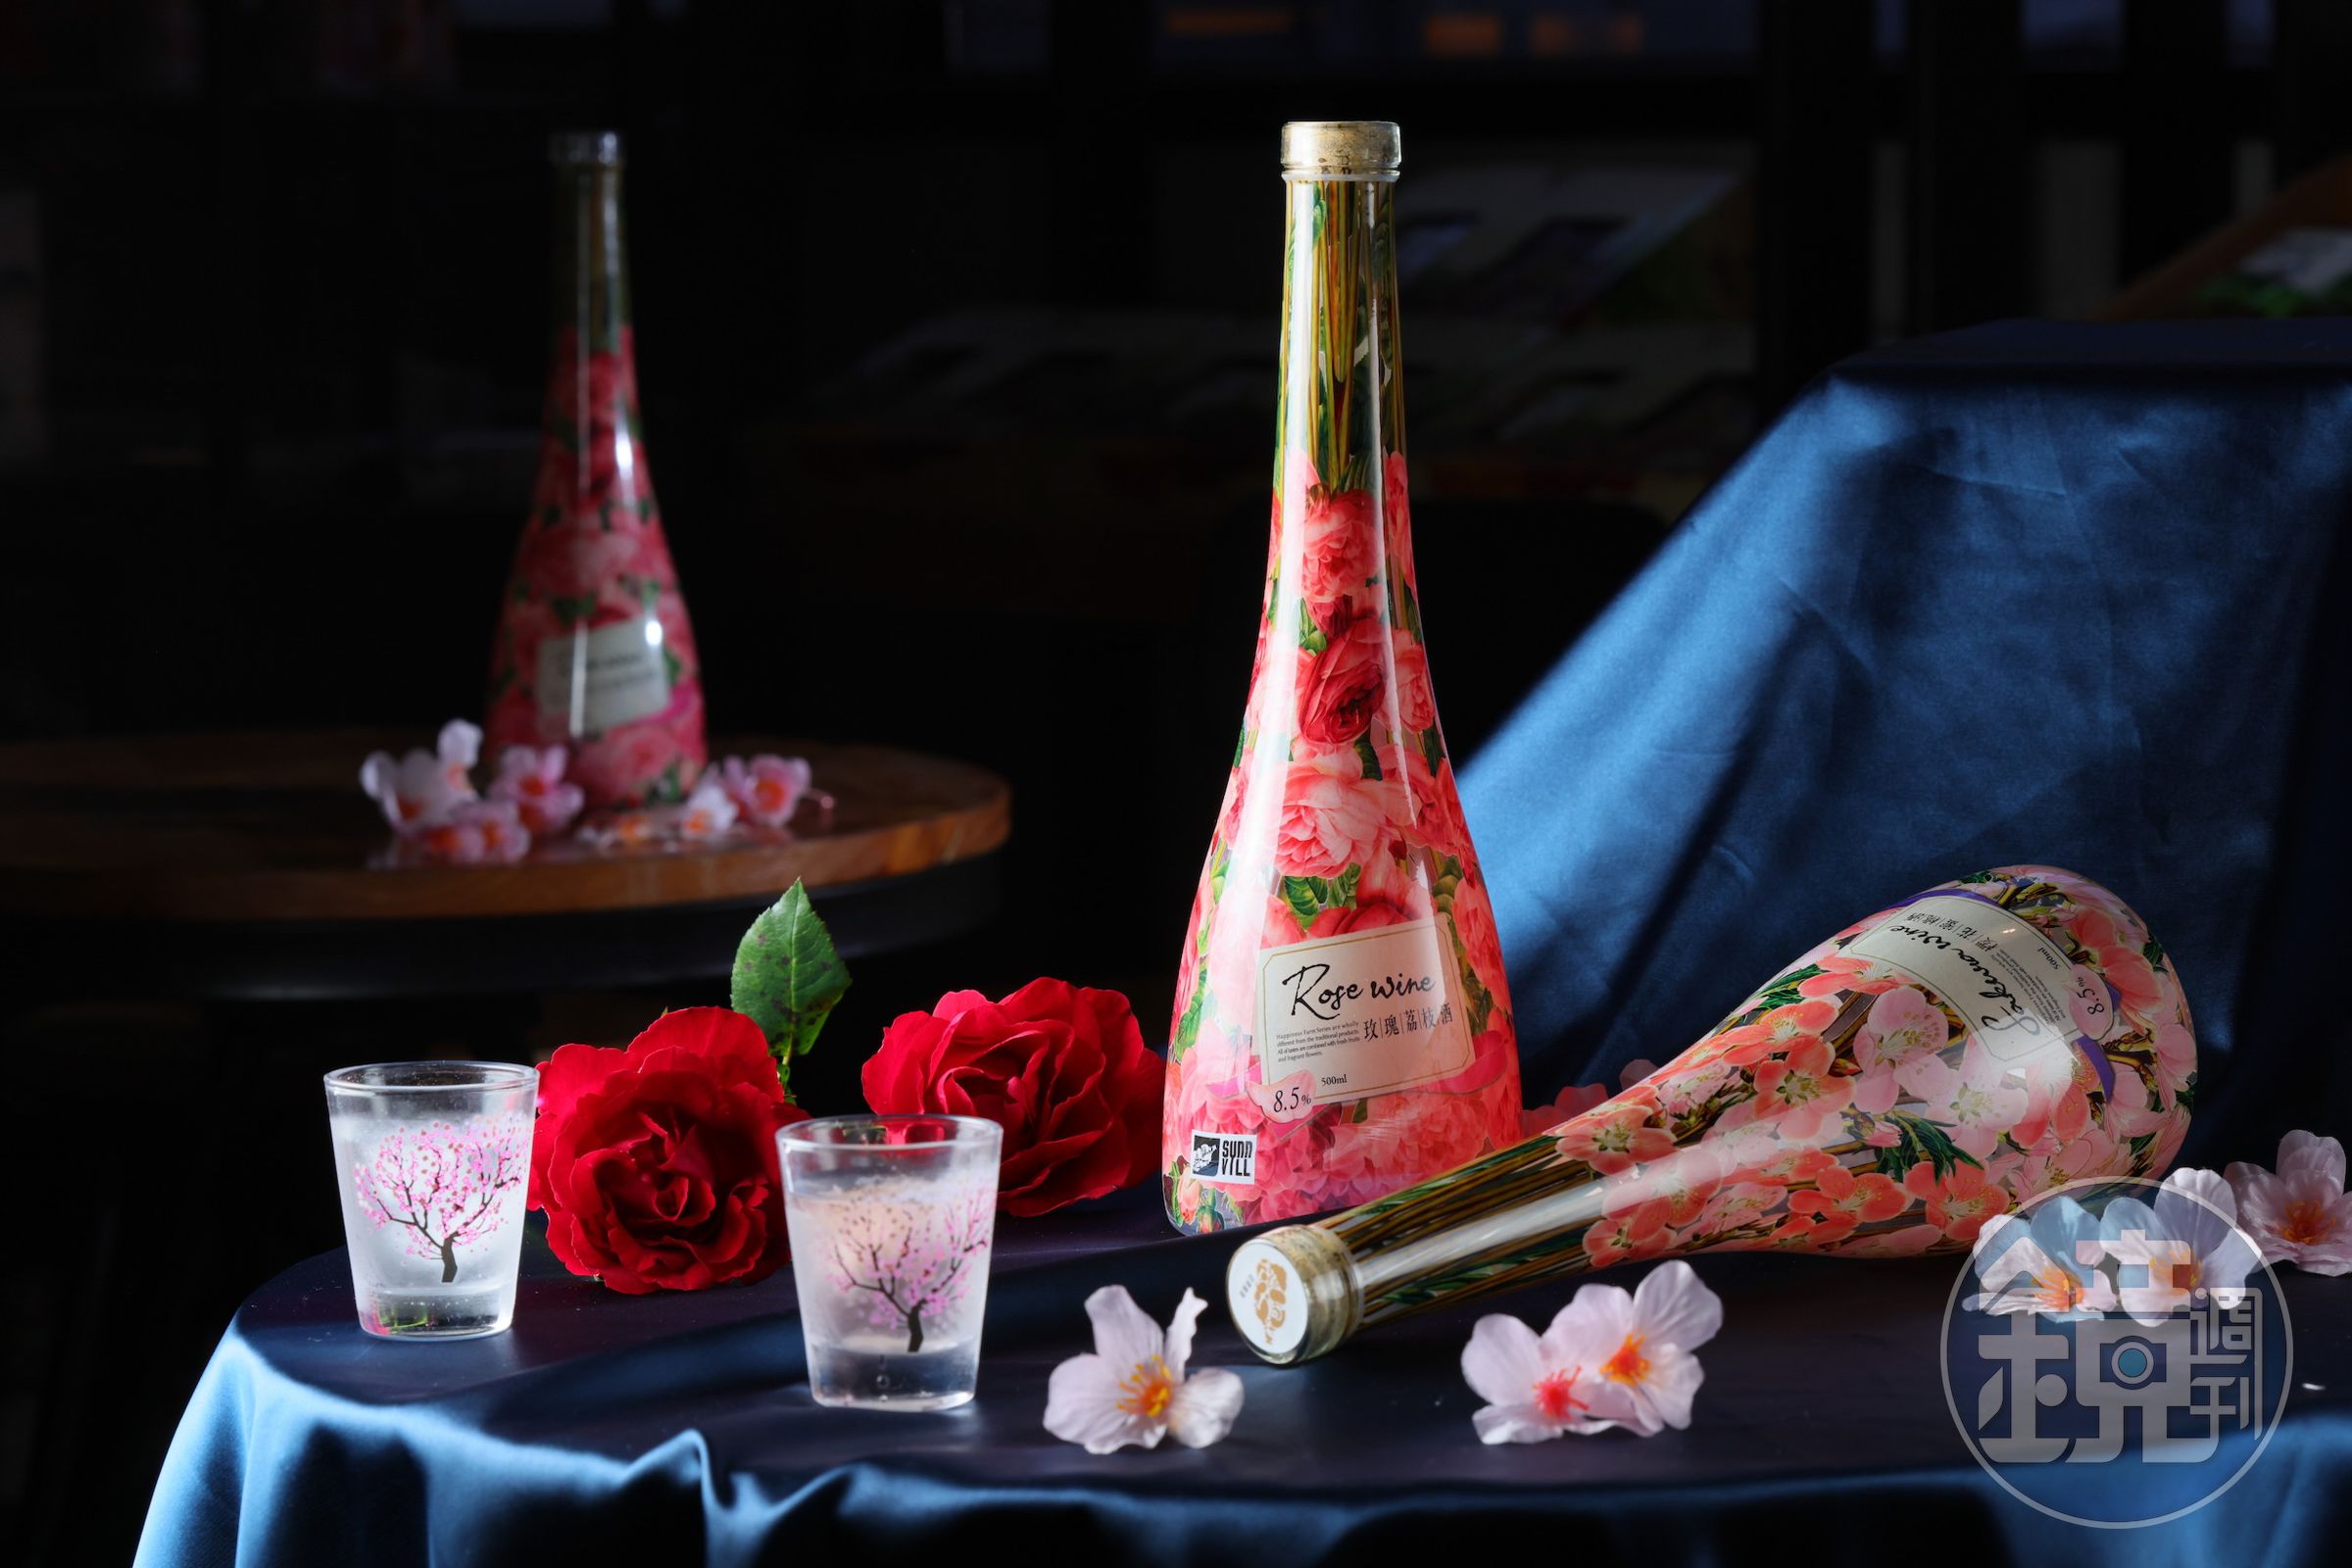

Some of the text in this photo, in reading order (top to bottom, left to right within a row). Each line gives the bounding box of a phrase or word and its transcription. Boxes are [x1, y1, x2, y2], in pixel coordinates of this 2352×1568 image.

[1887, 925, 1951, 949] wine
[2037, 947, 2061, 970] 500ml
[1282, 963, 1436, 1020] Rose wine
[1950, 948, 2040, 1035] Sakura
[2077, 976, 2104, 1015] 8.5%
[1321, 1073, 1348, 1087] 500ml
[1273, 1086, 1312, 1113] 8.5%
